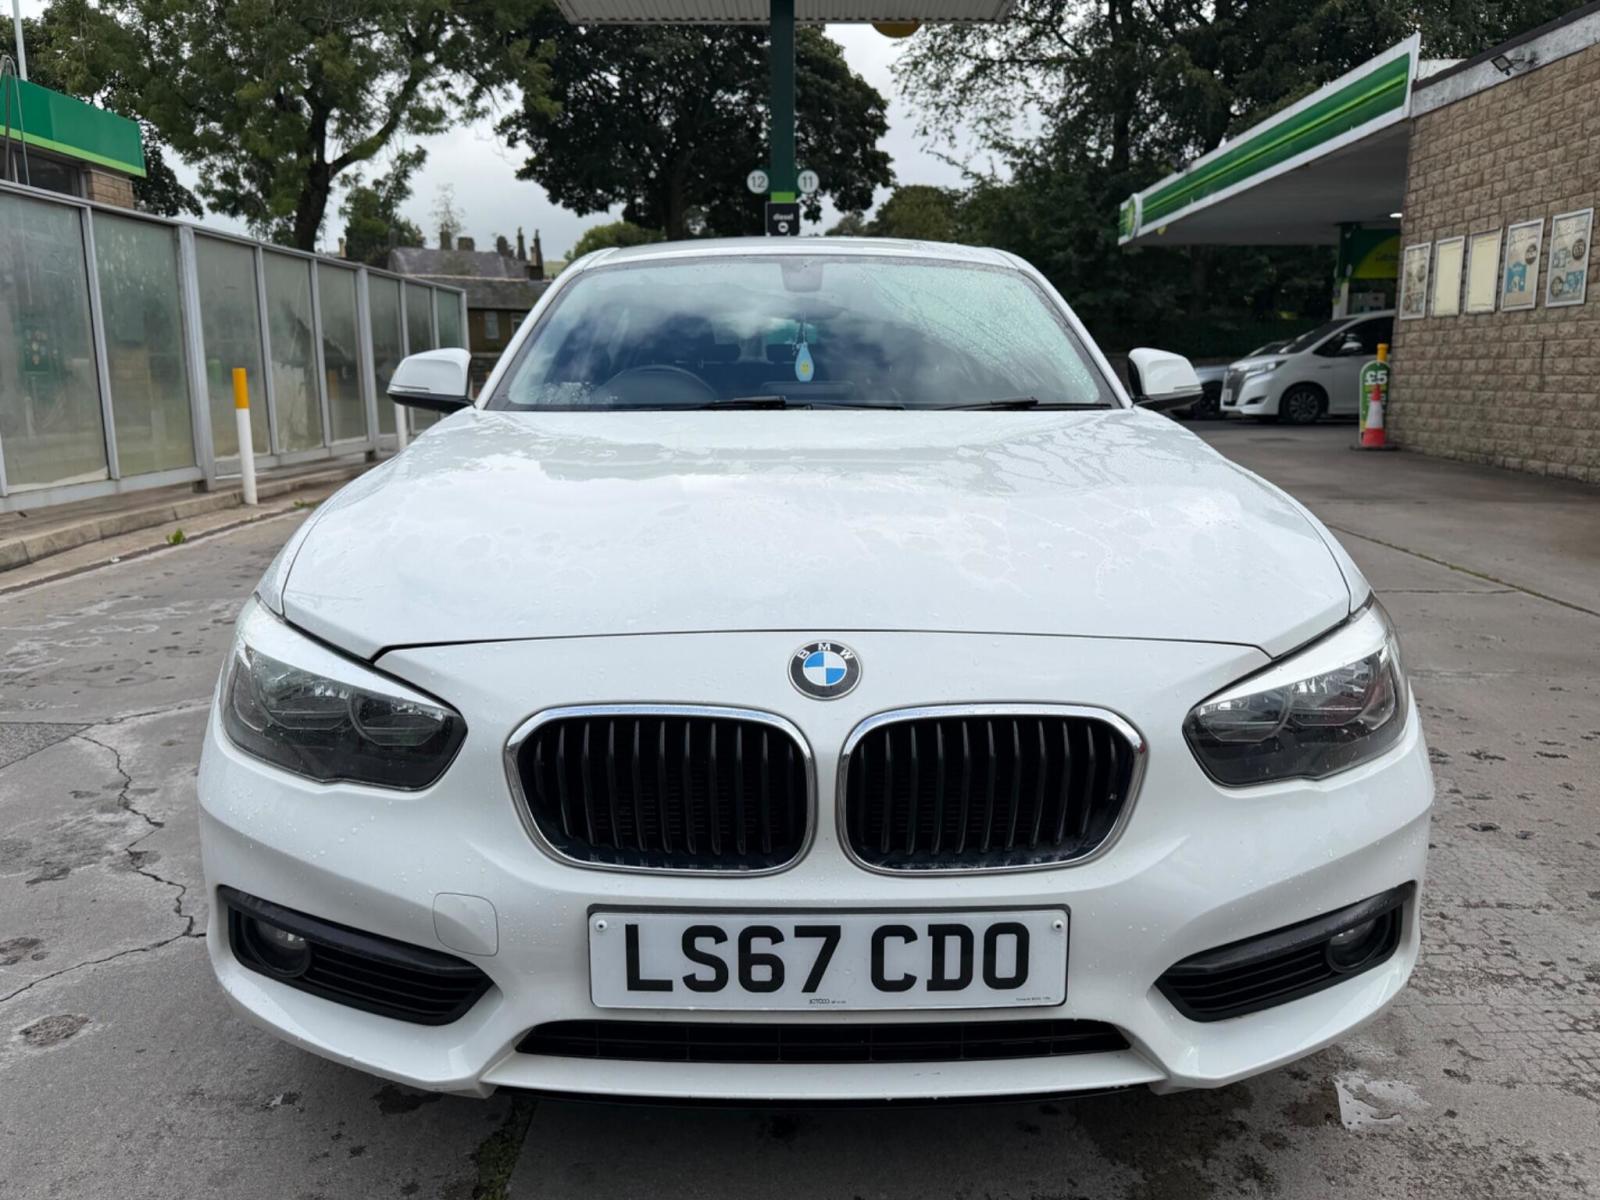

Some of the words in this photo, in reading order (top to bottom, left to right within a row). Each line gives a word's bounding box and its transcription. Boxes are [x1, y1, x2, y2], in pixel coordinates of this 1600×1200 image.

[751, 175, 766, 189] 12
[802, 175, 814, 189] 11
[773, 213, 794, 221] diesel
[1365, 370, 1388, 385] £5
[797, 643, 854, 660] BMW
[625, 923, 841, 993] LS67
[870, 921, 1030, 993] CDO
